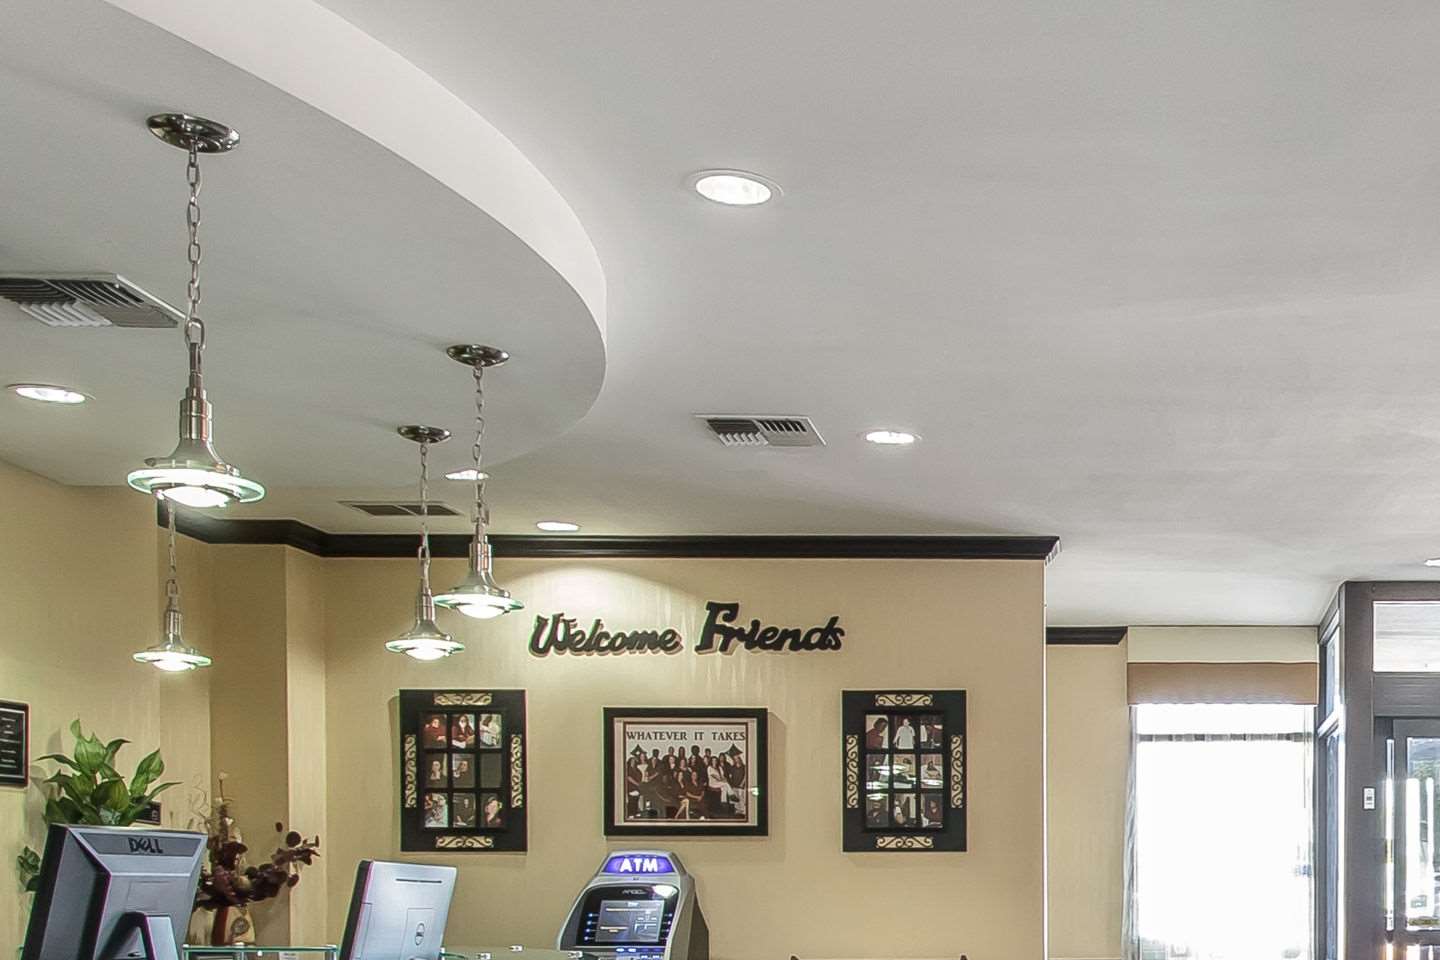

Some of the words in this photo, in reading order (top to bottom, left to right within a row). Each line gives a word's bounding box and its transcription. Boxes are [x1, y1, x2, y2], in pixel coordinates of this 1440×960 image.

[528, 612, 683, 656] Welcome
[694, 600, 845, 654] Friends
[626, 731, 687, 741] WHATEVER
[694, 731, 705, 741] IT
[712, 731, 746, 741] TAKES
[127, 837, 164, 854] DELL
[620, 858, 659, 872] ATM
